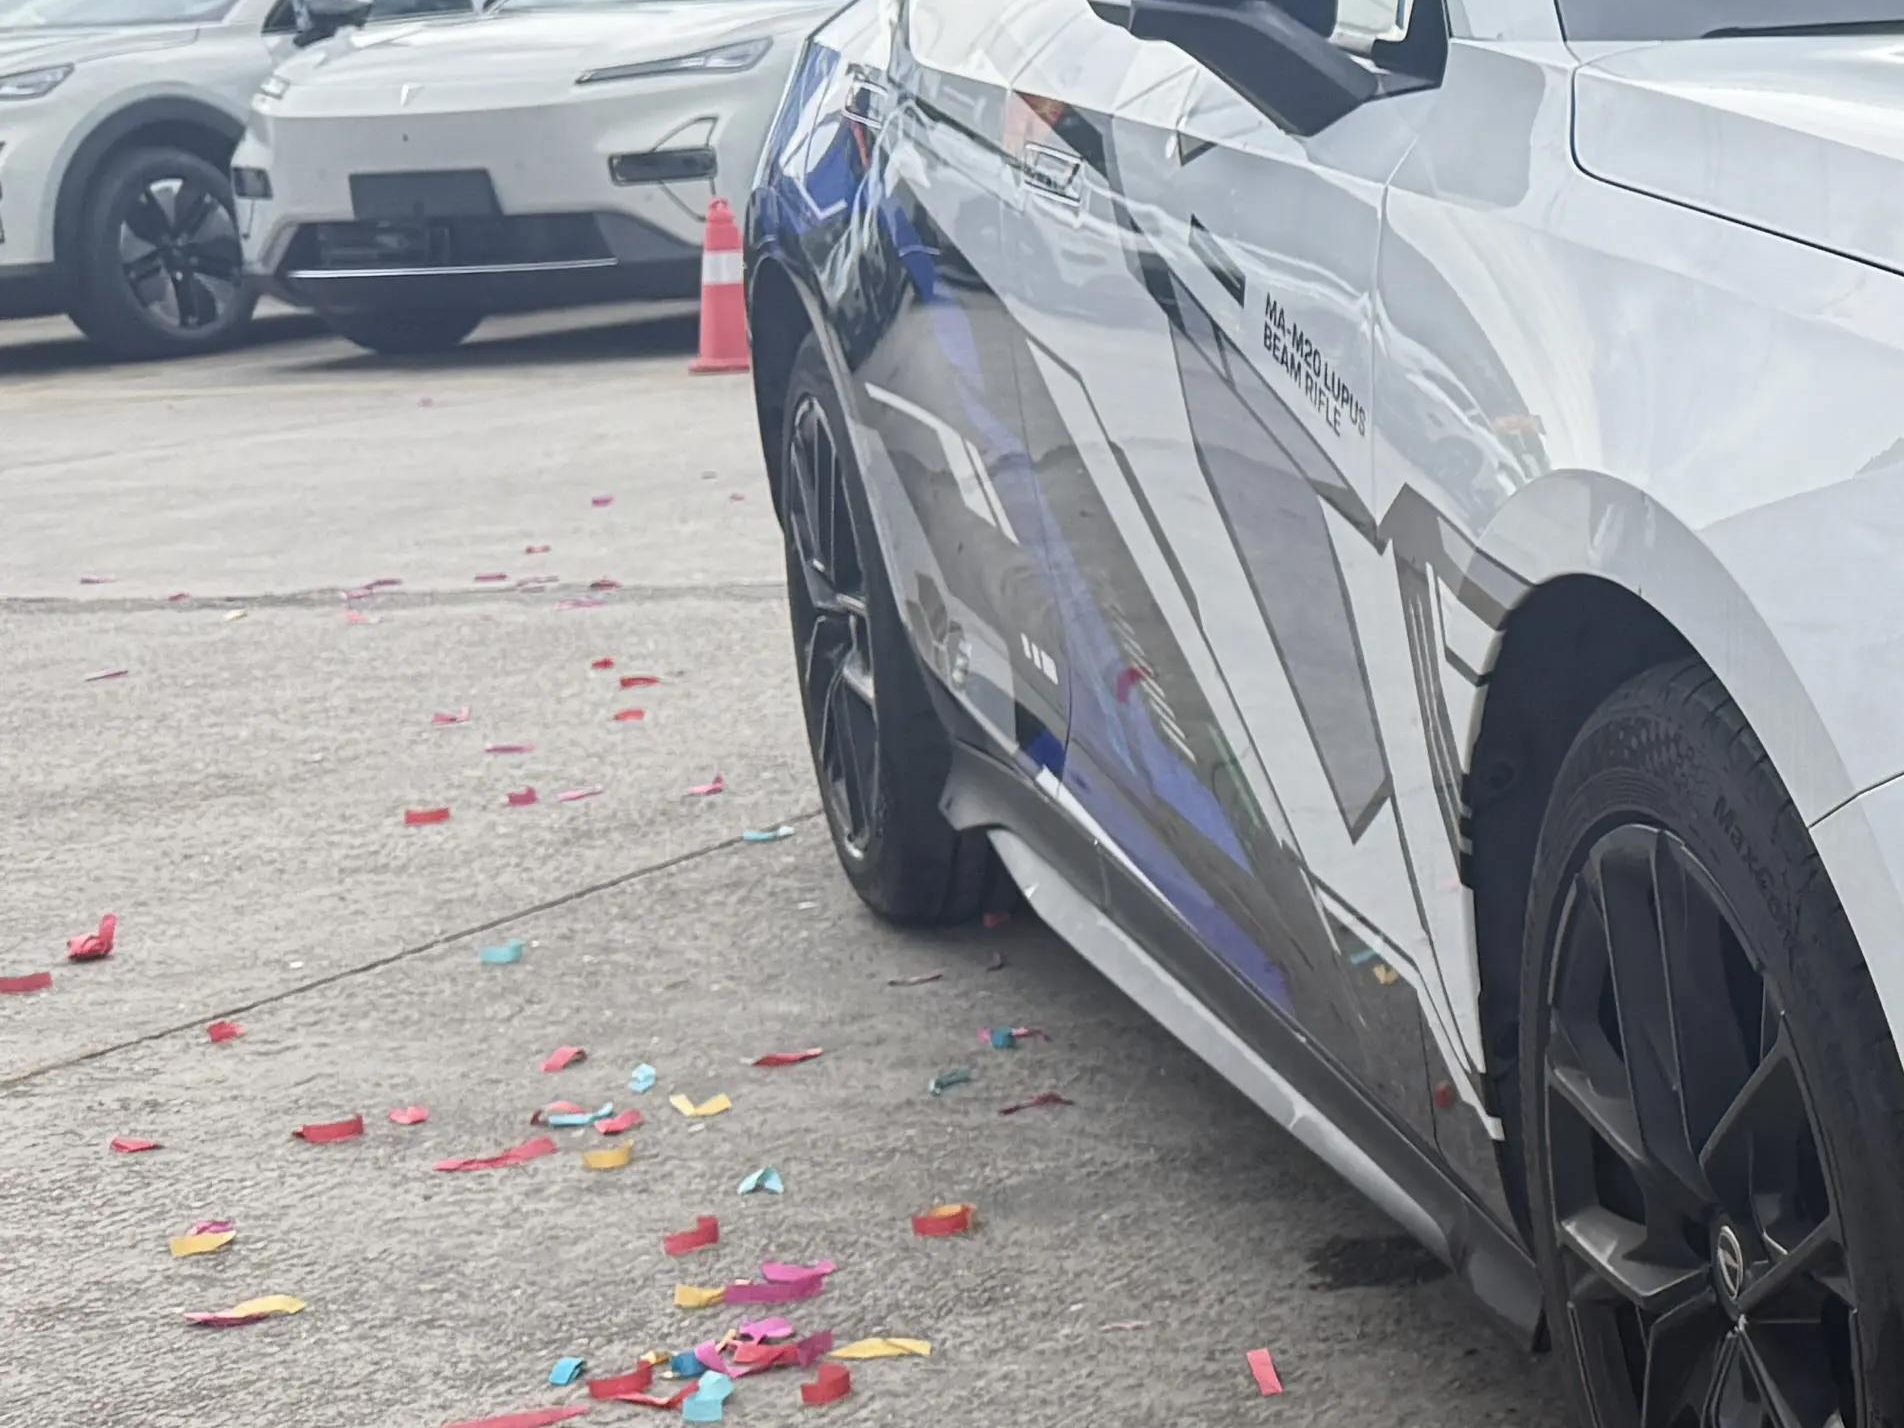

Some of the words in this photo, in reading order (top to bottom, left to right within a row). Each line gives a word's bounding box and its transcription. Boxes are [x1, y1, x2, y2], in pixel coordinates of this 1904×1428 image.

[1263, 320, 1302, 389] BEAM
[1305, 369, 1342, 438] RIFLE
[1265, 291, 1321, 378] MA-M20
[1324, 361, 1366, 437] LUPUS
